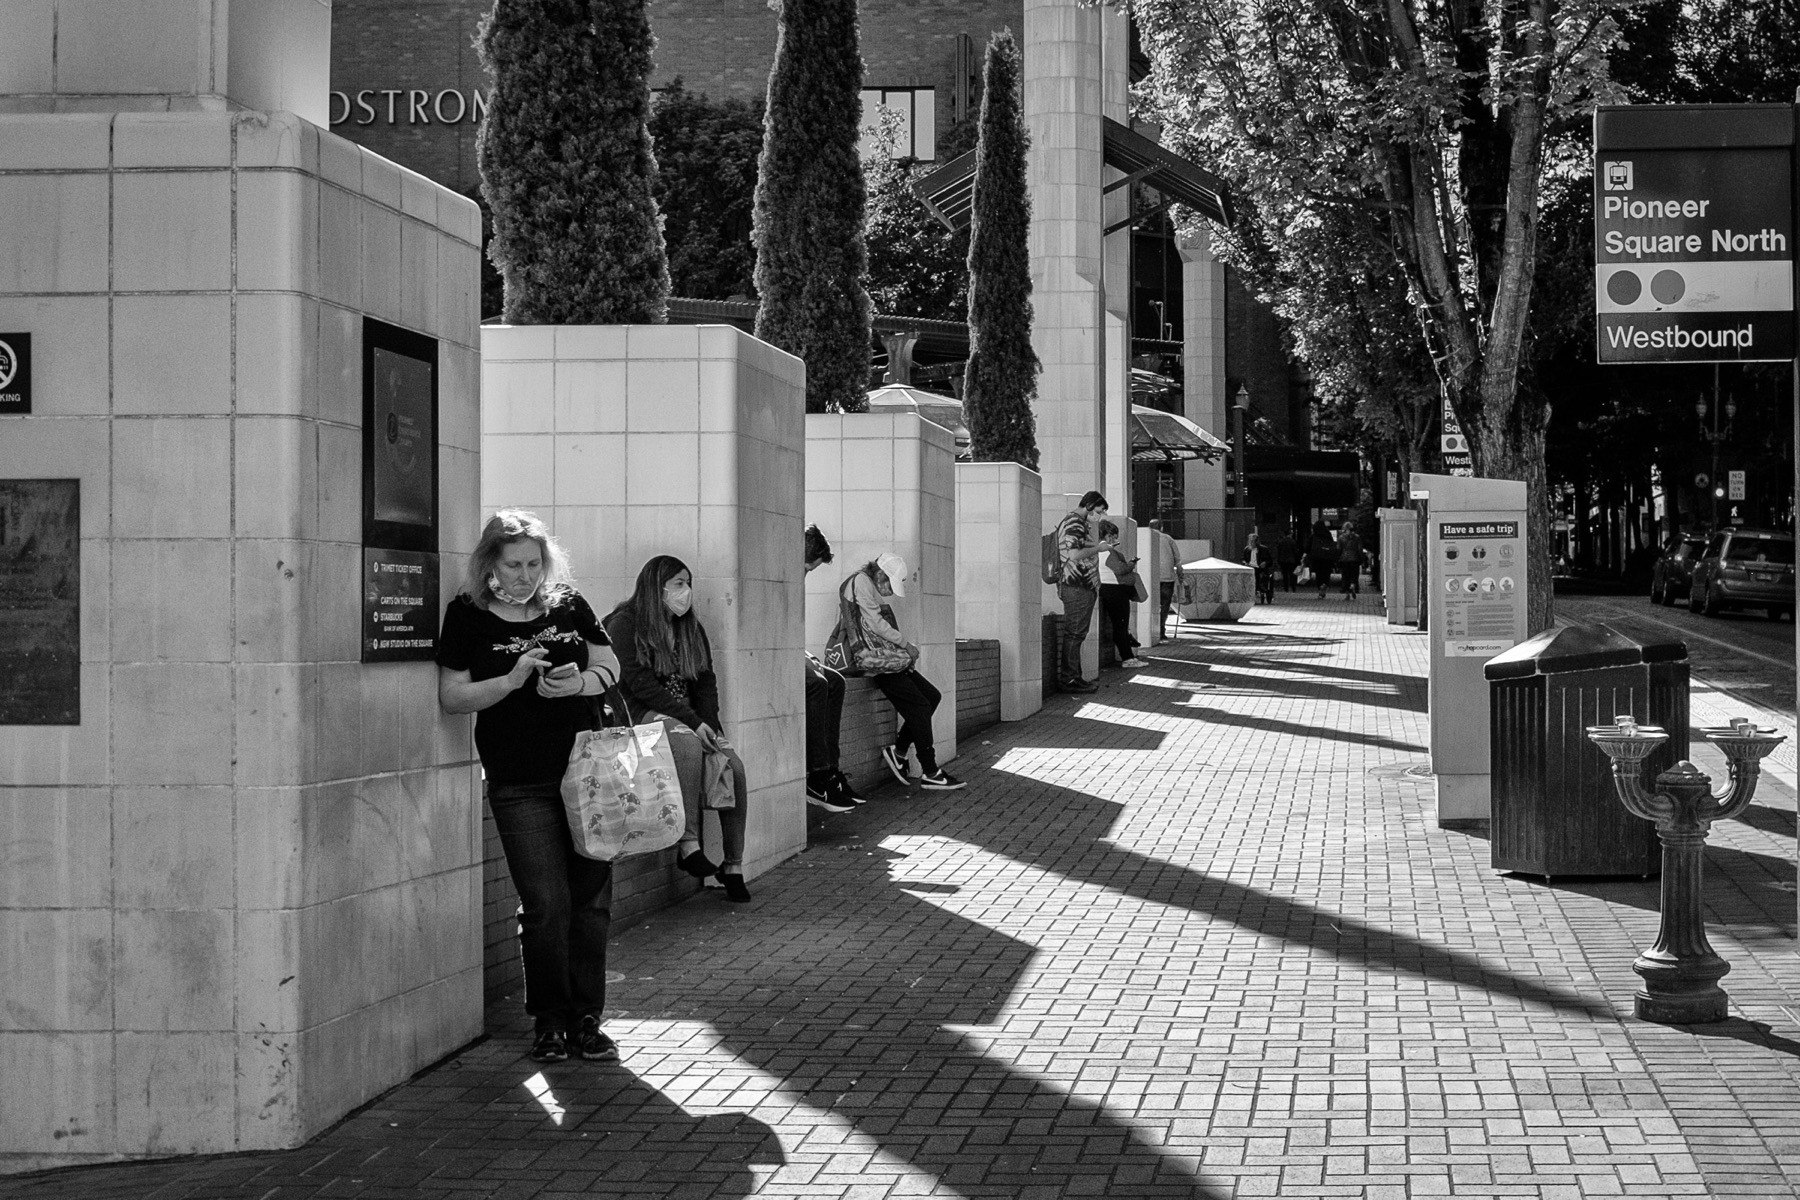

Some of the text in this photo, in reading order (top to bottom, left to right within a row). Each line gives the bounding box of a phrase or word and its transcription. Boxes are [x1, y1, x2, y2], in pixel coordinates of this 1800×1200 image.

[1604, 196, 1709, 219] Pioneer
[1605, 228, 1786, 259] Square North
[1606, 323, 1753, 349] Westbound
[1443, 525, 1466, 534] Have
[1476, 525, 1495, 534] safe
[1497, 524, 1513, 534] trip
[409, 566, 422, 574] OFFICE
[380, 613, 403, 621] STARBUCKS
